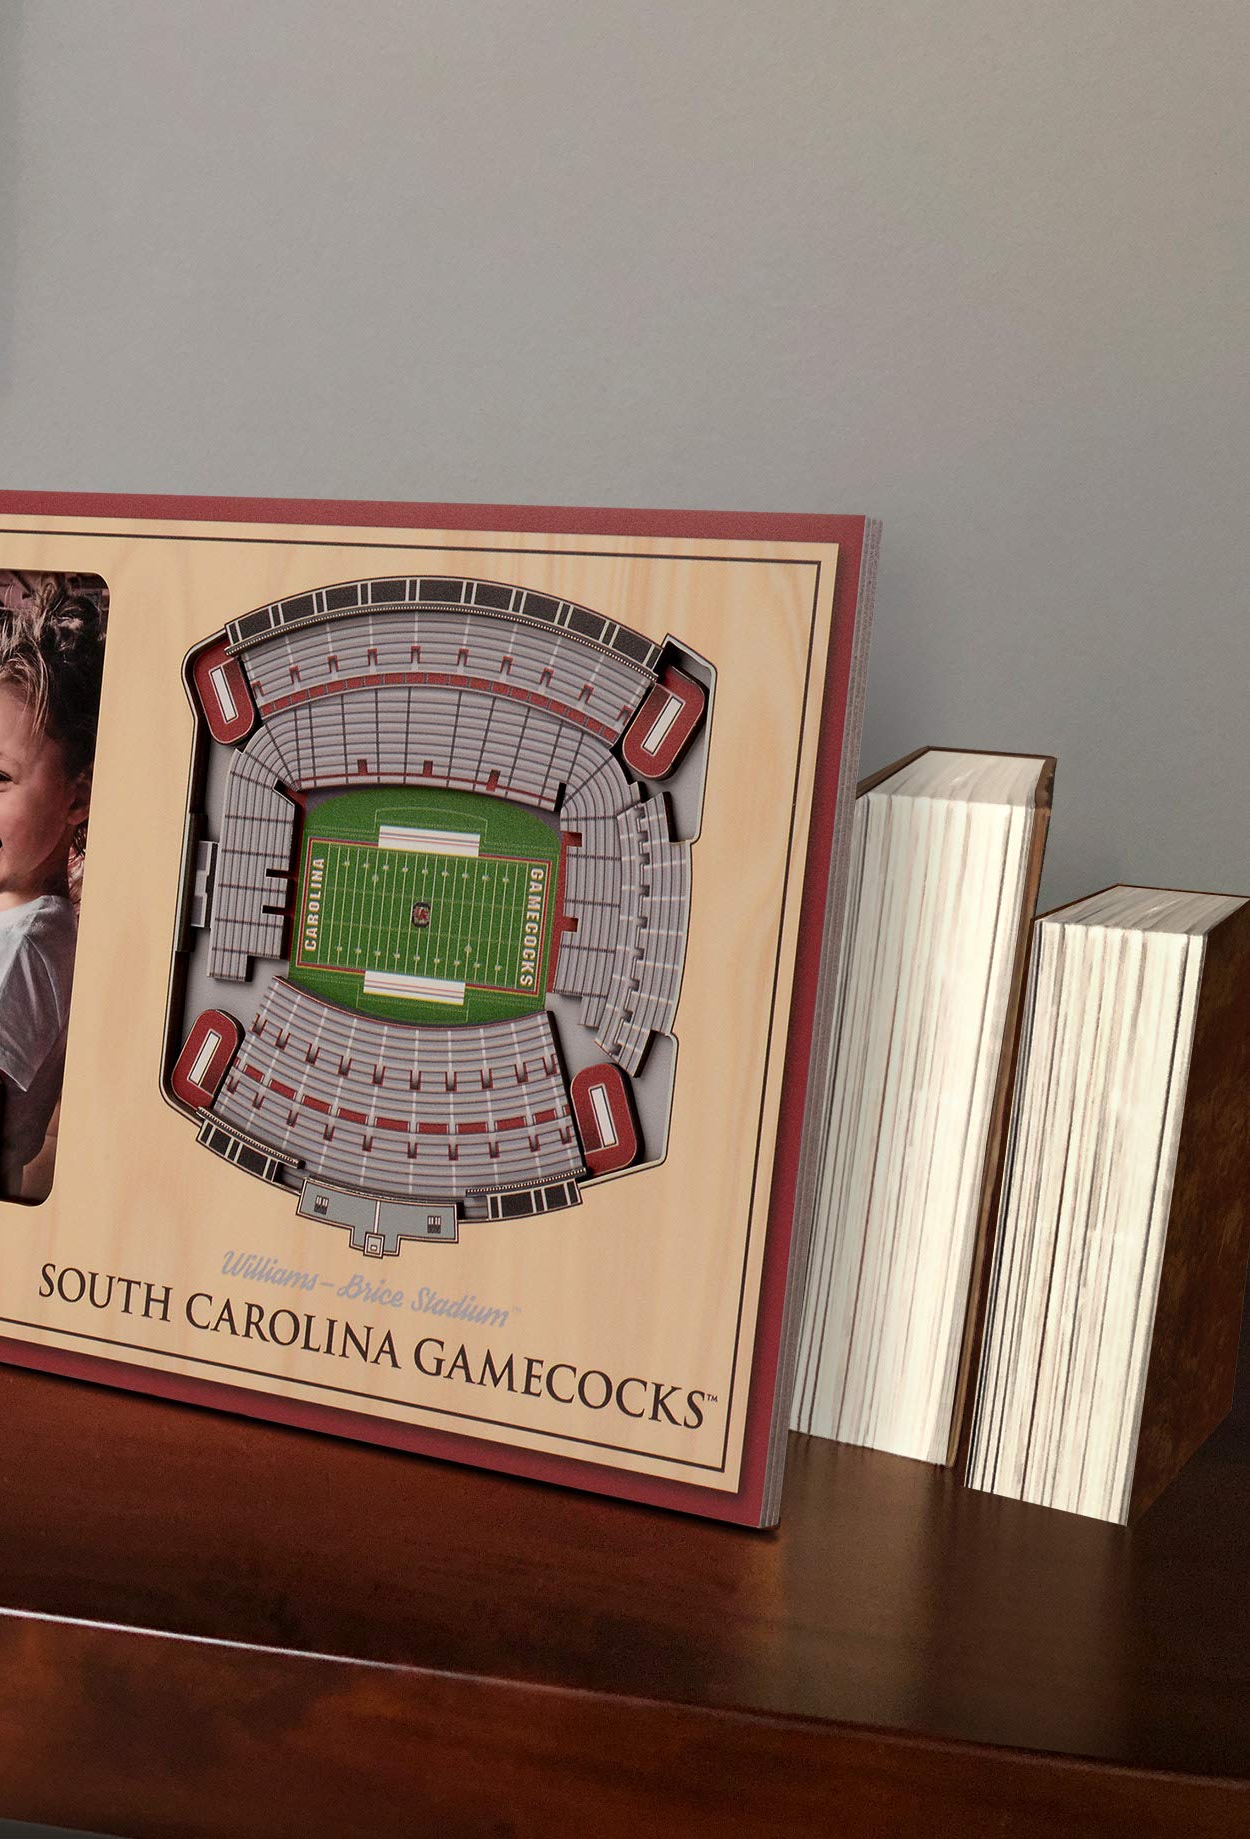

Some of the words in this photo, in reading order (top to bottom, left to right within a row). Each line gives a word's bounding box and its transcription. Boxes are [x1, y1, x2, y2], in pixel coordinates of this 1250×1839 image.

[304, 858, 325, 952] CAROLINA
[519, 867, 545, 987] GAMECOCKS
[38, 1262, 173, 1323] SOUTH
[185, 1292, 403, 1370] CAROLINA
